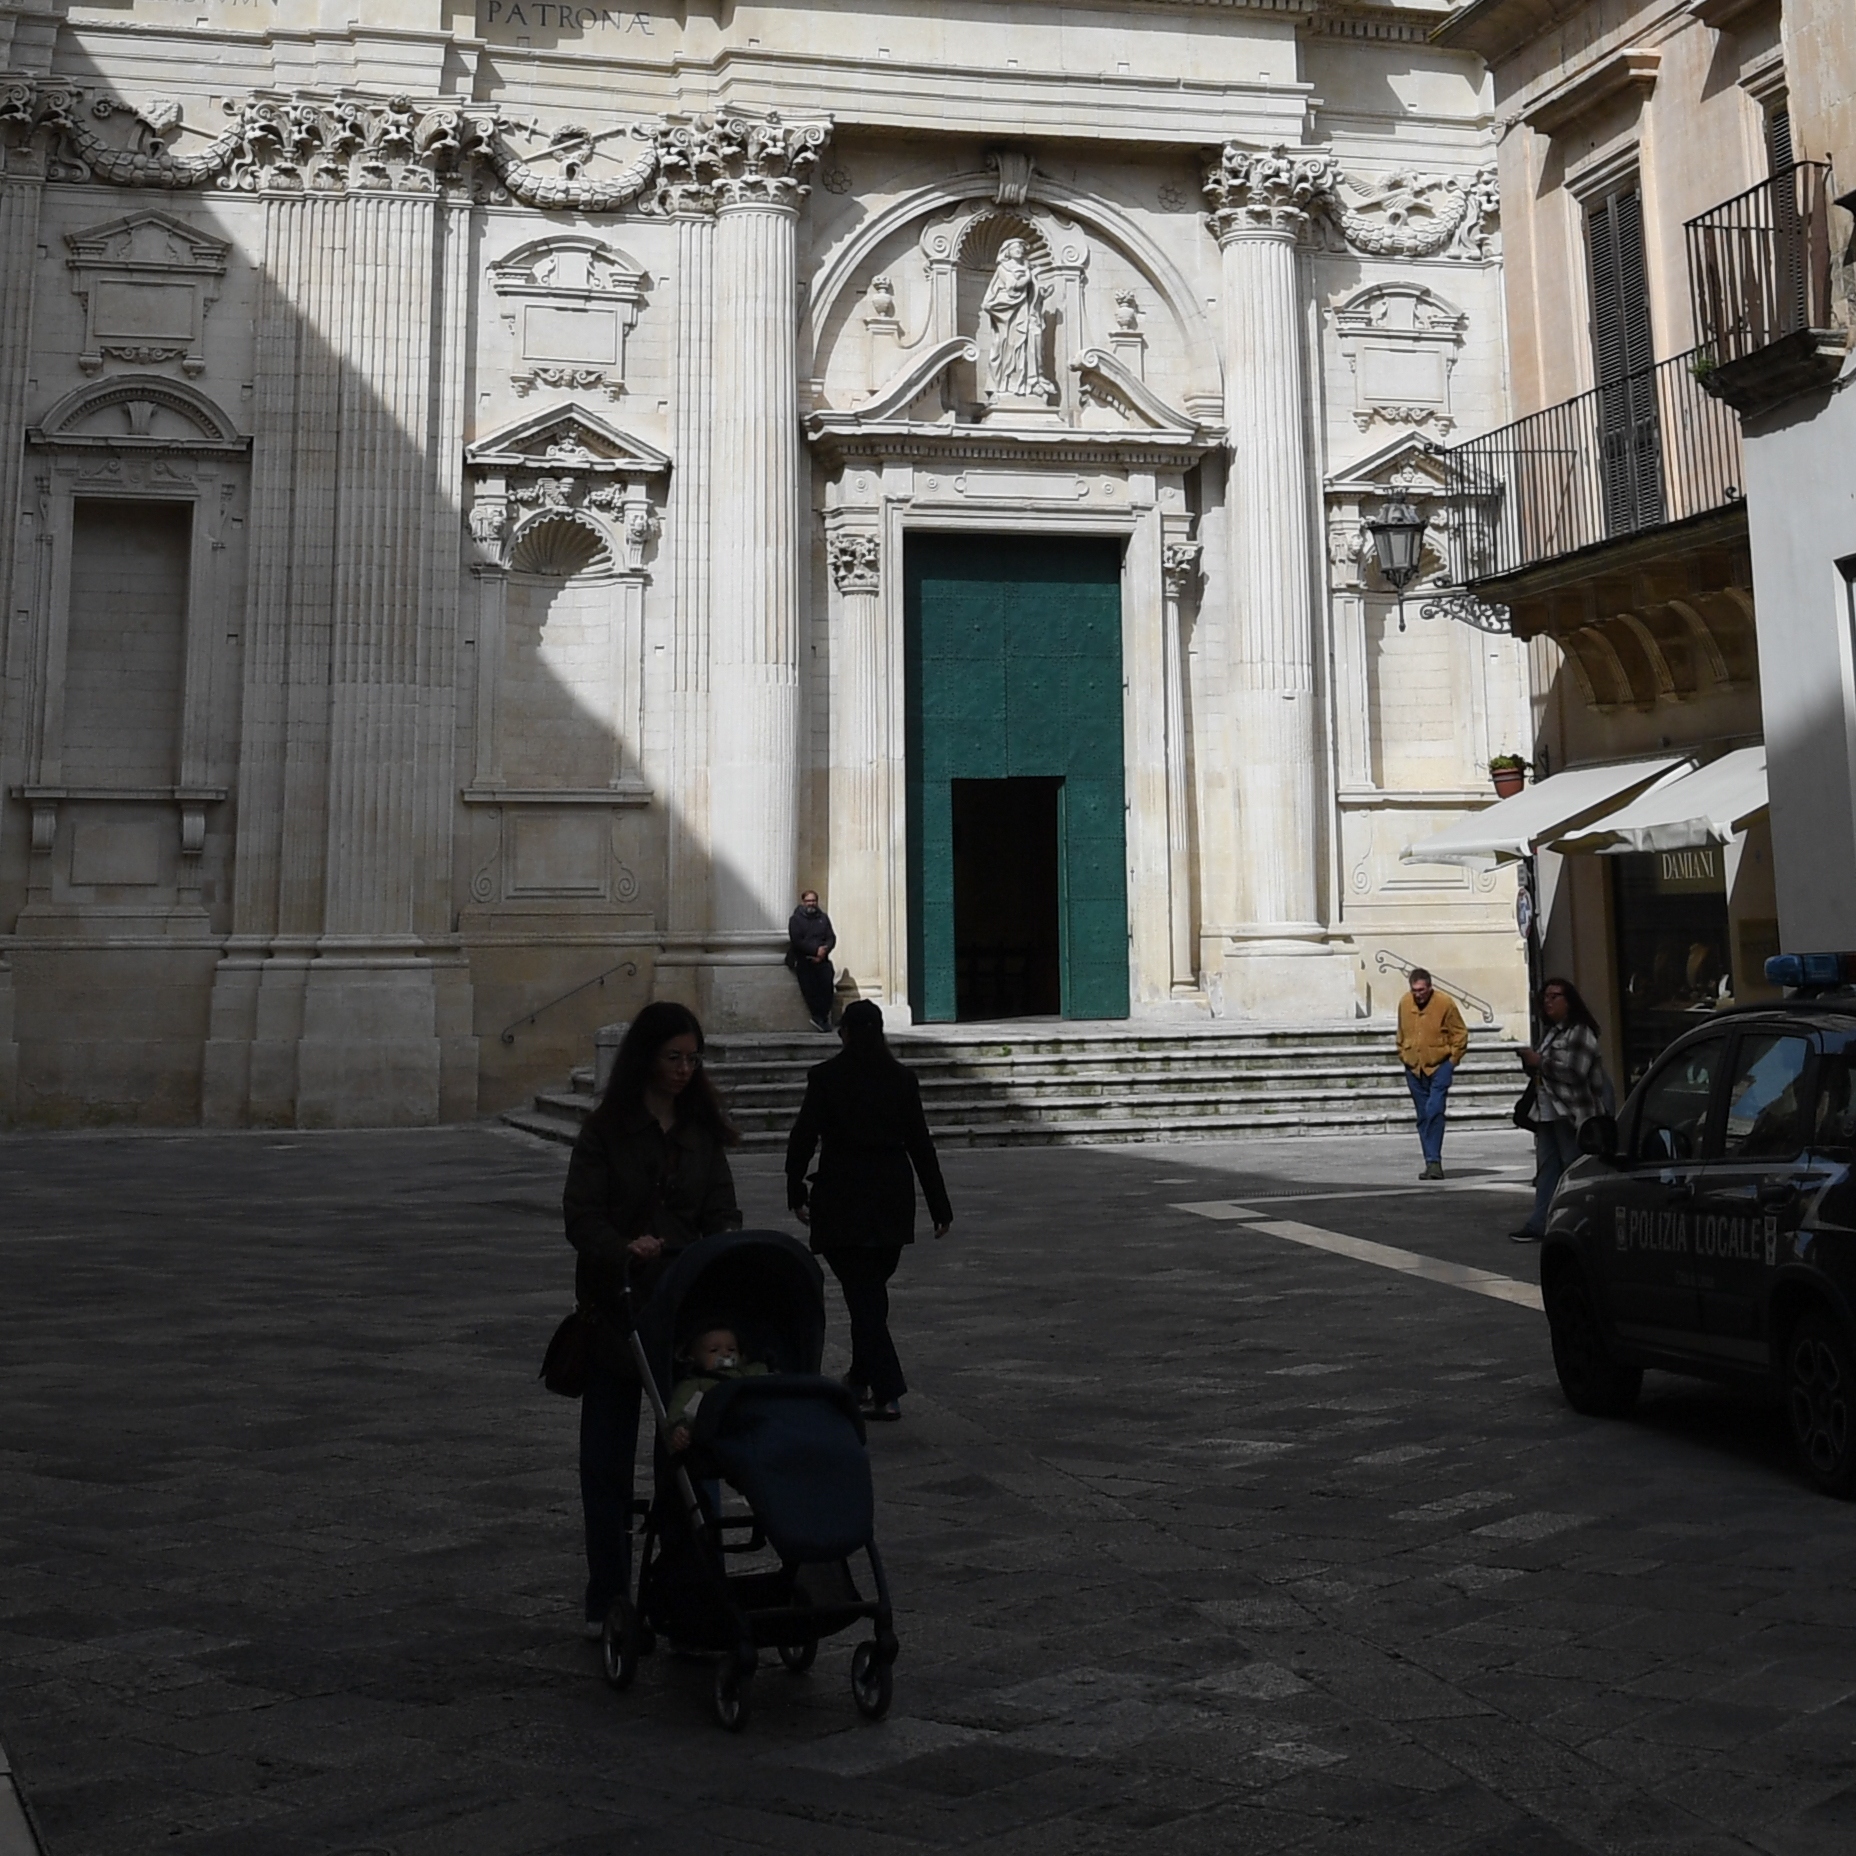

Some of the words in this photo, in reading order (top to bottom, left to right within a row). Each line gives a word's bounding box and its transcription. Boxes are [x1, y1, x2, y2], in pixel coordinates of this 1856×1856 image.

[1662, 850, 1715, 879] DAMIANI
[1629, 1209, 1688, 1252] POLIZIA
[1694, 1214, 1762, 1260] LOCALE
